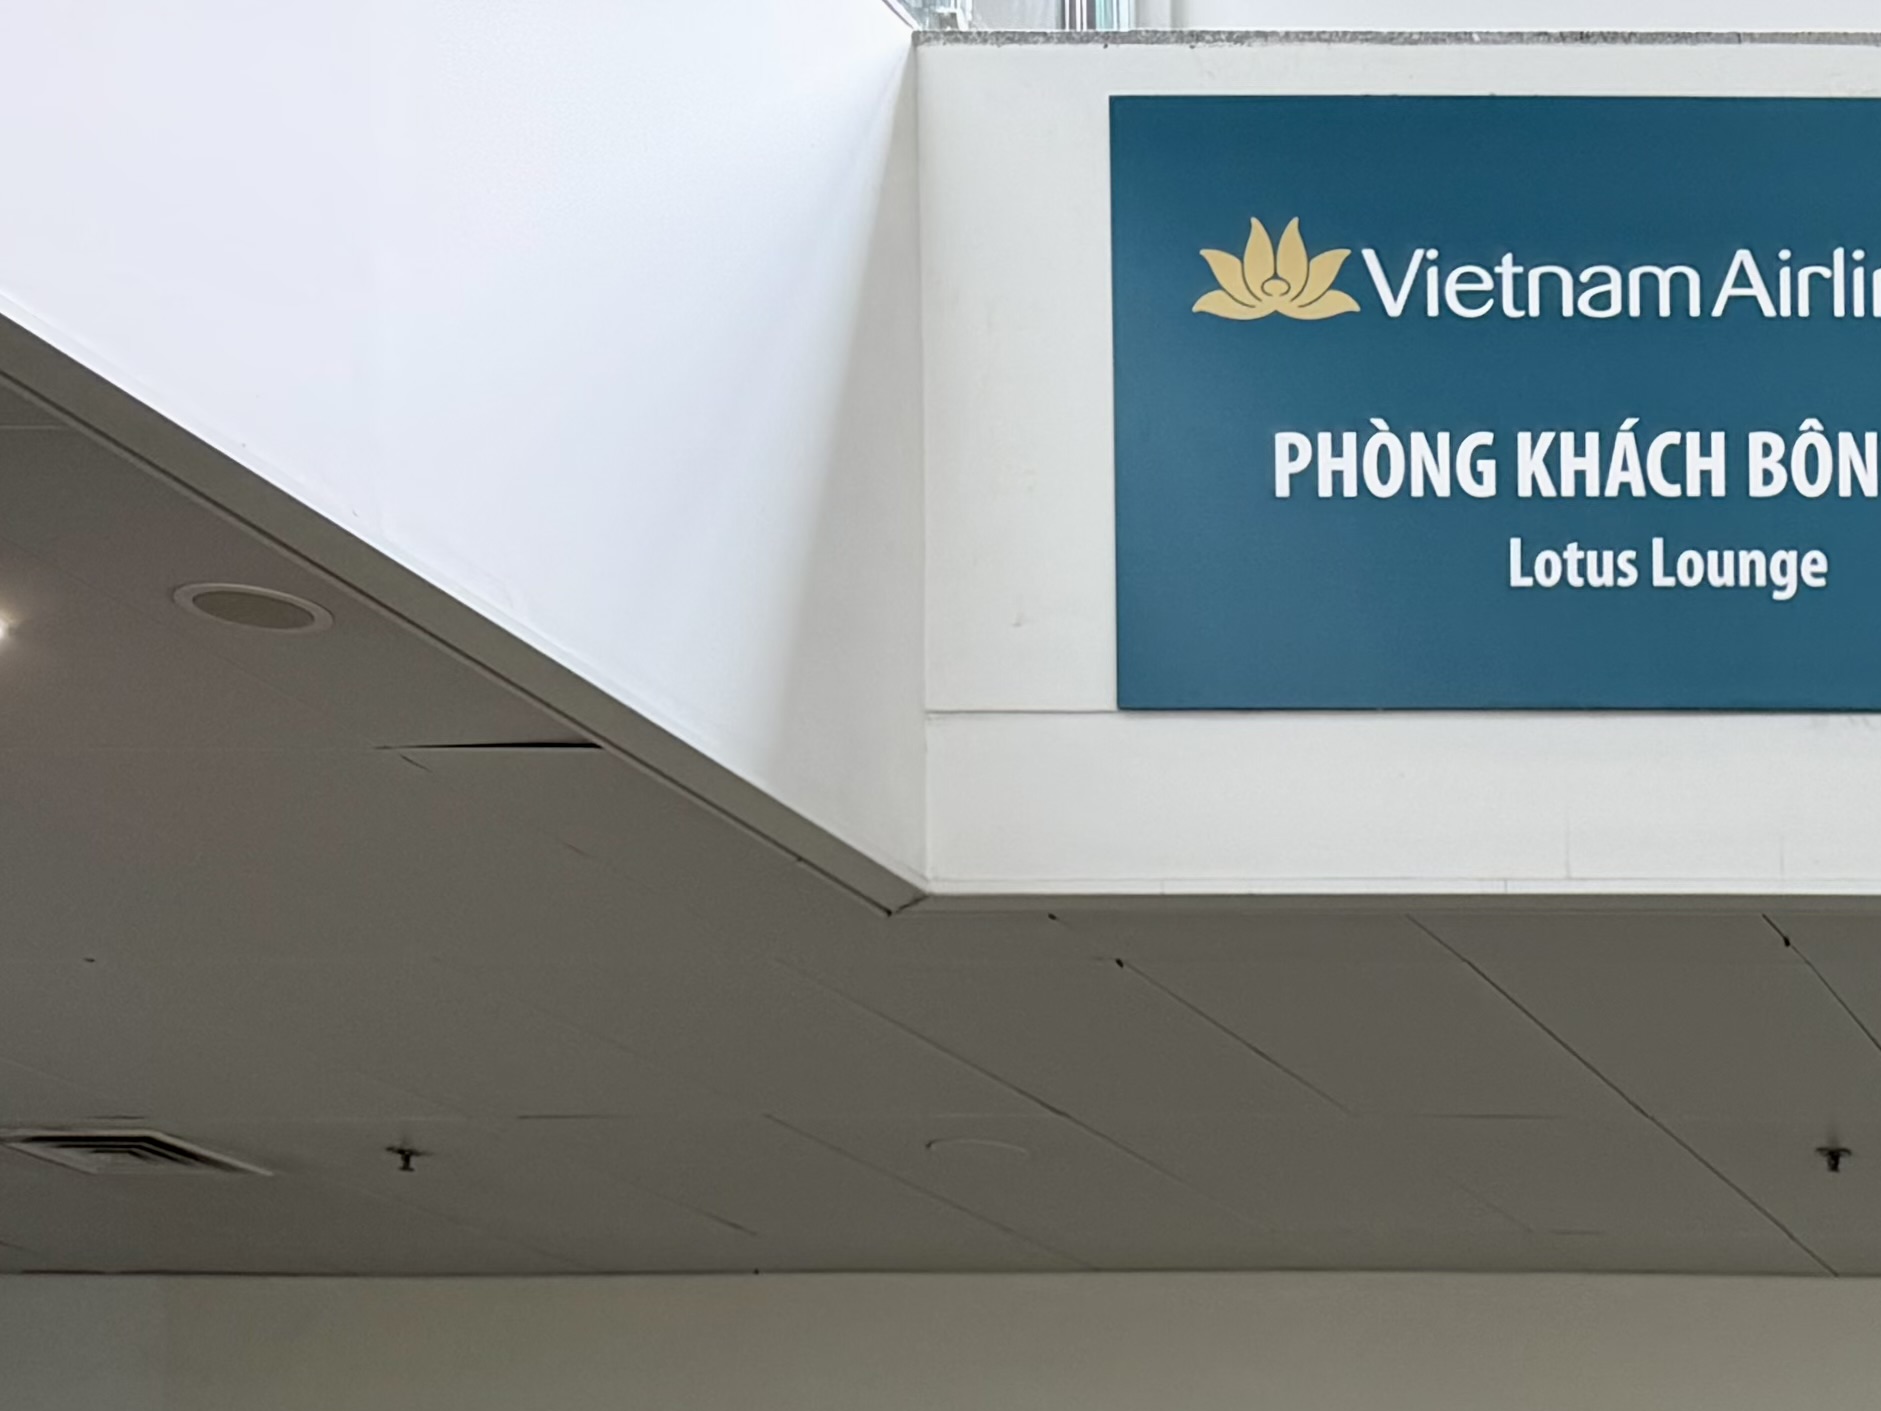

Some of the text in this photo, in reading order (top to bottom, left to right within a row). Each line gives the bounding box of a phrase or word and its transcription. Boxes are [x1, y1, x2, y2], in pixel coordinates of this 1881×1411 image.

[1361, 249, 1702, 319] Vietnam
[1274, 419, 1495, 499] PHÒNG
[1518, 419, 1727, 499] KHÁCH
[1509, 538, 1827, 598] Lotus Lounge
